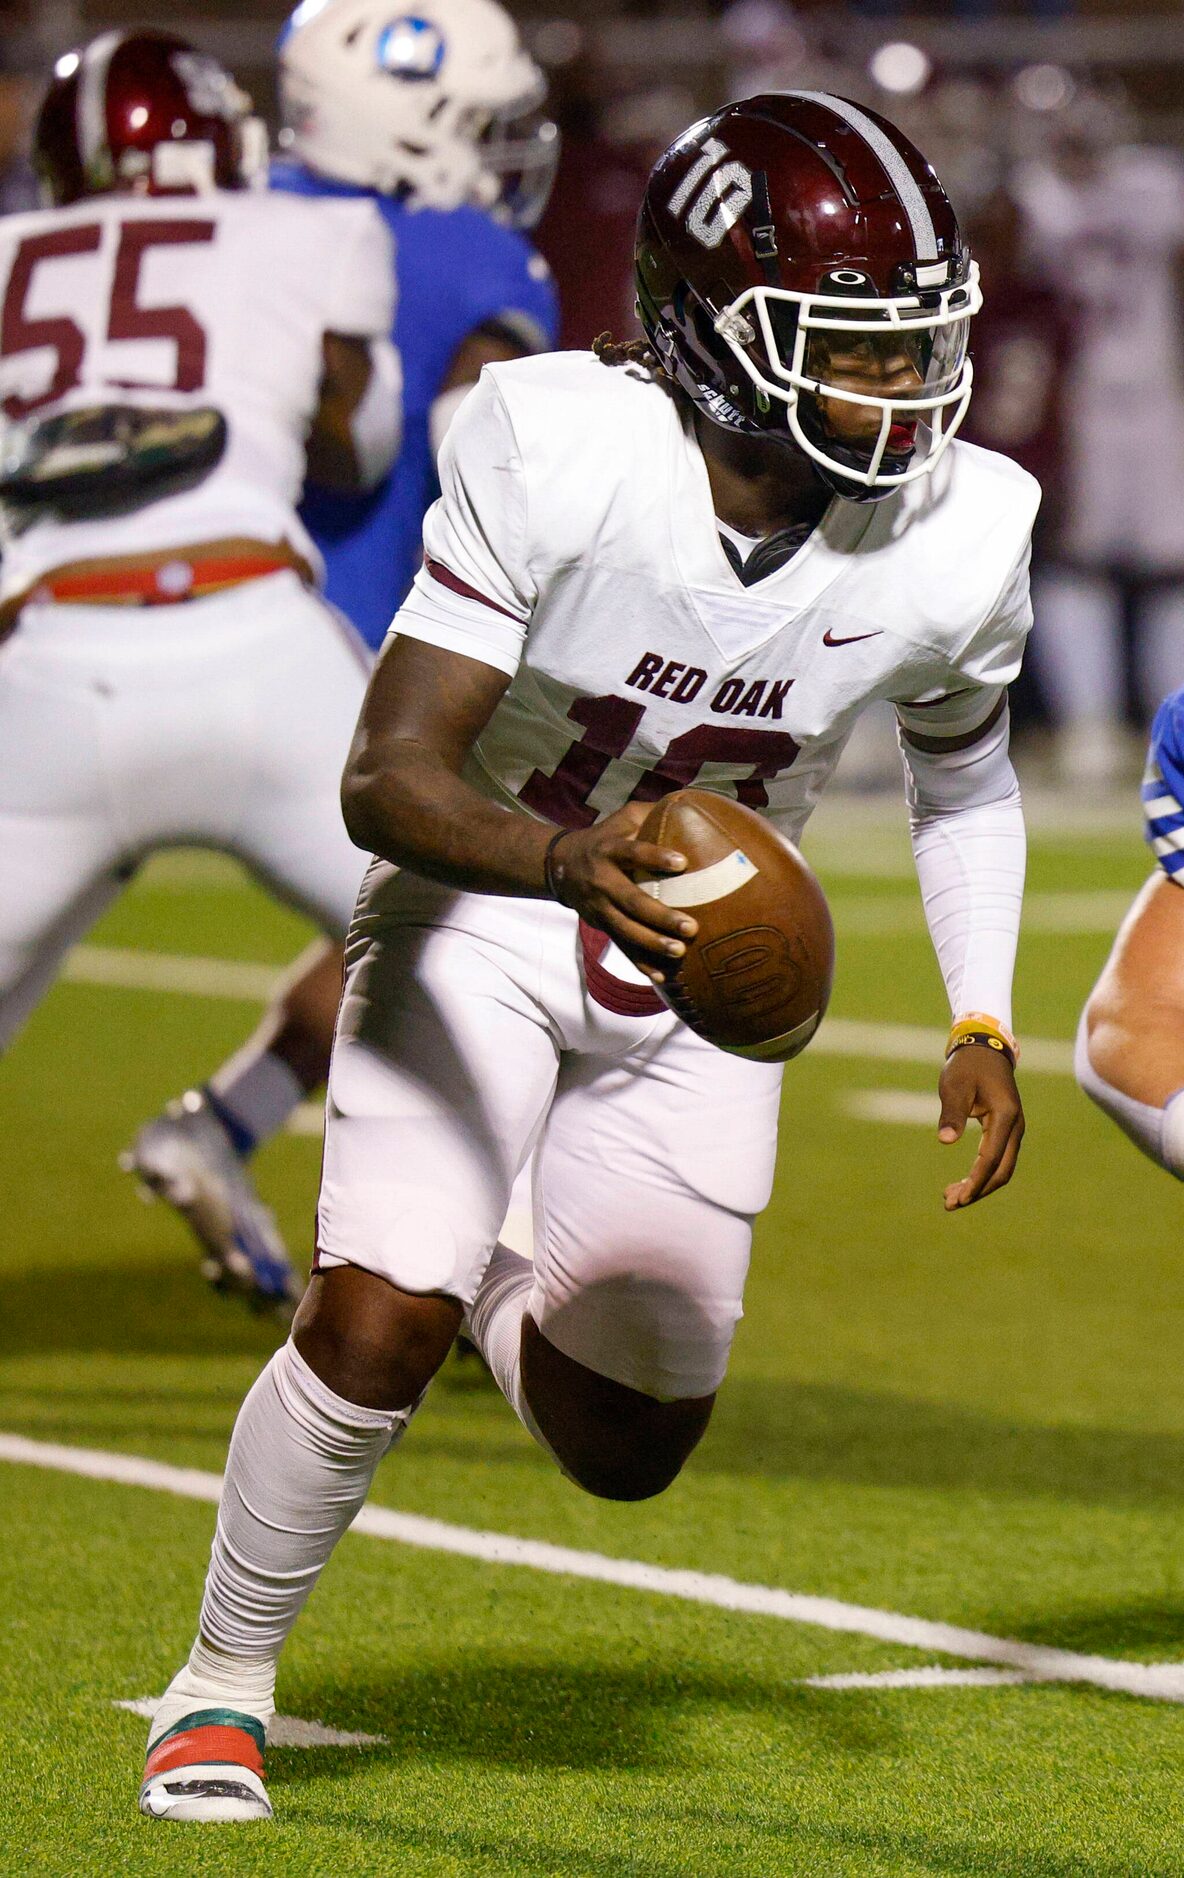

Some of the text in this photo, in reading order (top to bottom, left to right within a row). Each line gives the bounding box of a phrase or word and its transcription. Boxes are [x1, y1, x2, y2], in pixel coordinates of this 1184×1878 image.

[667, 137, 754, 249] 10
[0, 221, 216, 421] 55
[697, 384, 746, 427] SCHUTT
[625, 652, 796, 719] RED OAK
